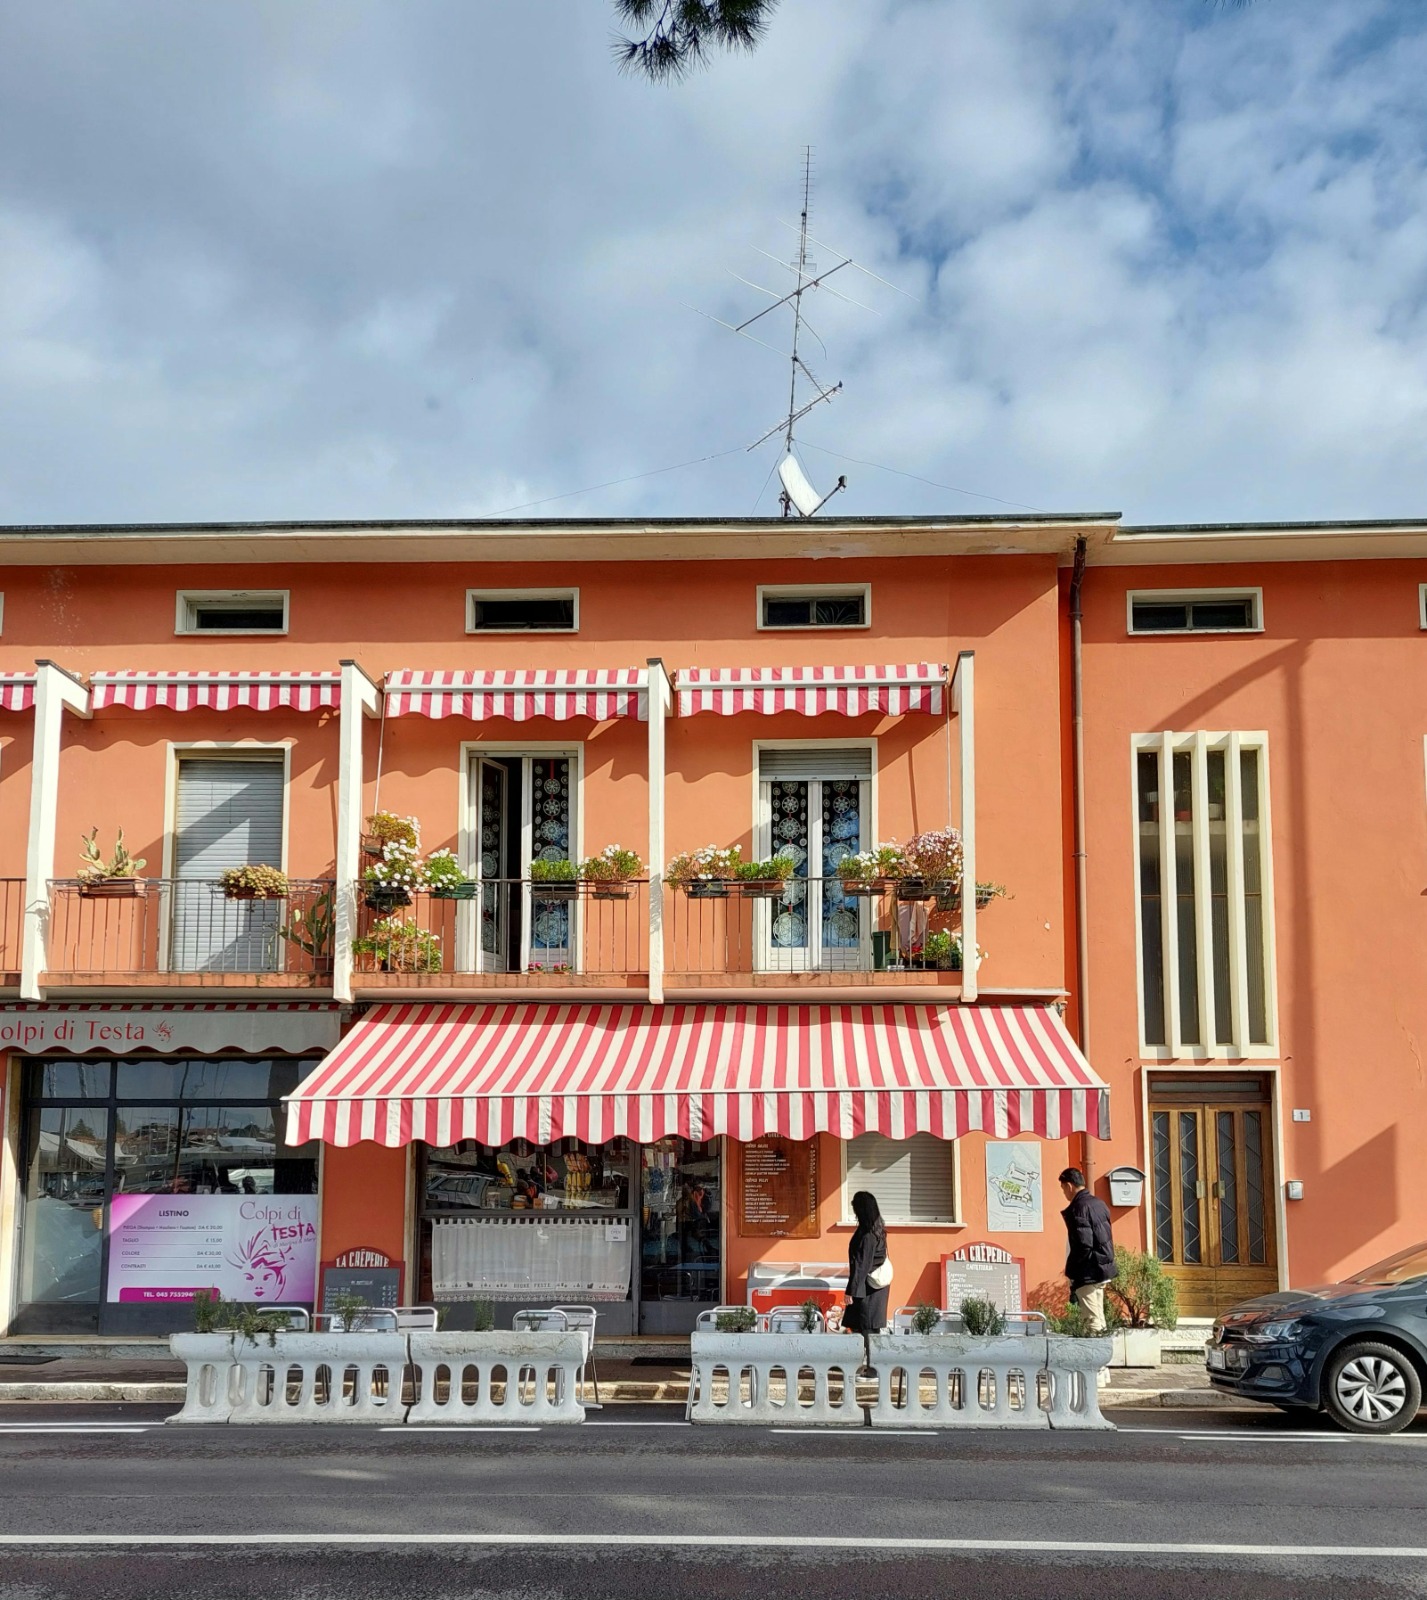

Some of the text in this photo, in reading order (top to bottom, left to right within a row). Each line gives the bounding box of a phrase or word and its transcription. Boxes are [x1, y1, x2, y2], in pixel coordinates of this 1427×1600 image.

[0, 1019, 145, 1046] olpi di Testa
[239, 1201, 302, 1224] Colpi di
[271, 1220, 316, 1243] TESTA
[336, 1248, 390, 1268] LA CRÊPERIE
[954, 1243, 1012, 1263] LA CRÊPERIE
